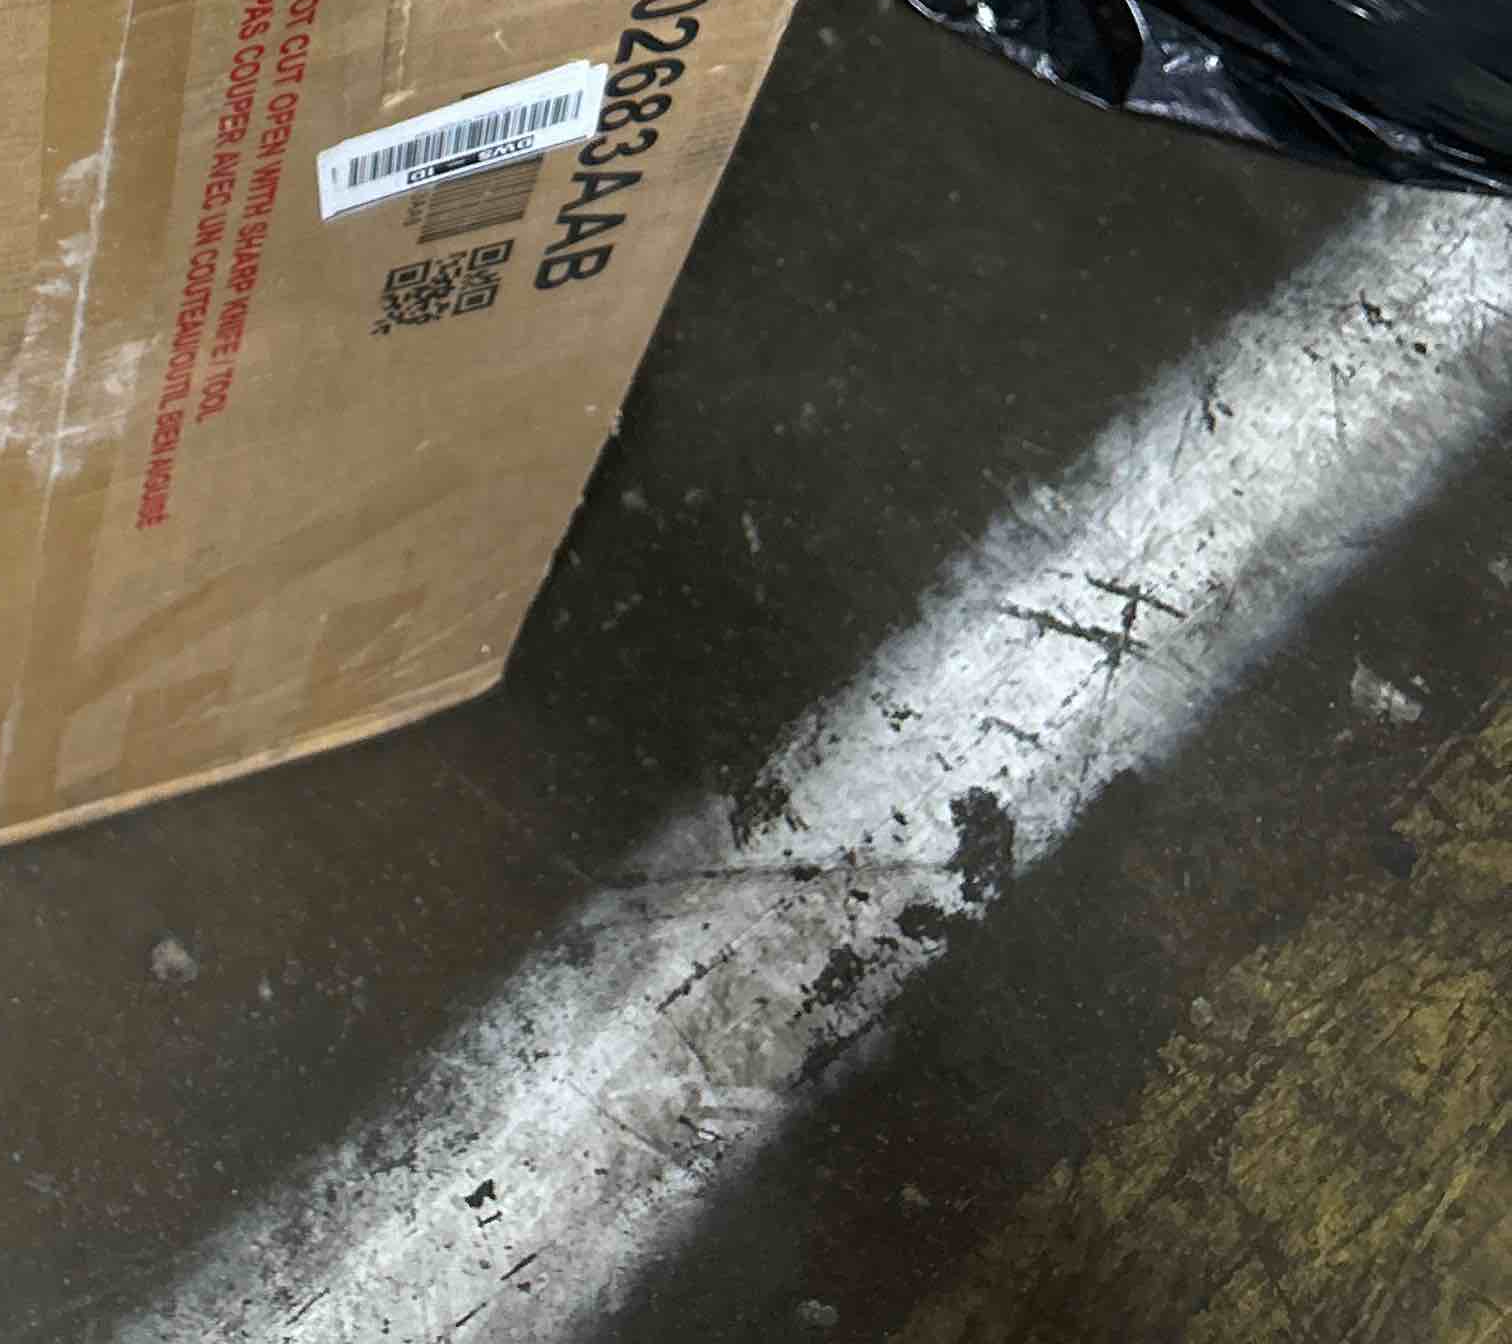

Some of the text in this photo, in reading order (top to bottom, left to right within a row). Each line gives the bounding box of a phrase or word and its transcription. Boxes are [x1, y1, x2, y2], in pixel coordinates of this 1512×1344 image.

[274, 33, 310, 85] CUT
[215, 44, 265, 148] COUPER
[256, 93, 299, 159] OPEN
[201, 151, 240, 211] AVEC
[244, 160, 281, 217] WITH
[195, 214, 227, 246] UN
[227, 221, 269, 294] SHARP
[210, 295, 249, 358] KNIFE
[150, 411, 184, 455] BIEN
